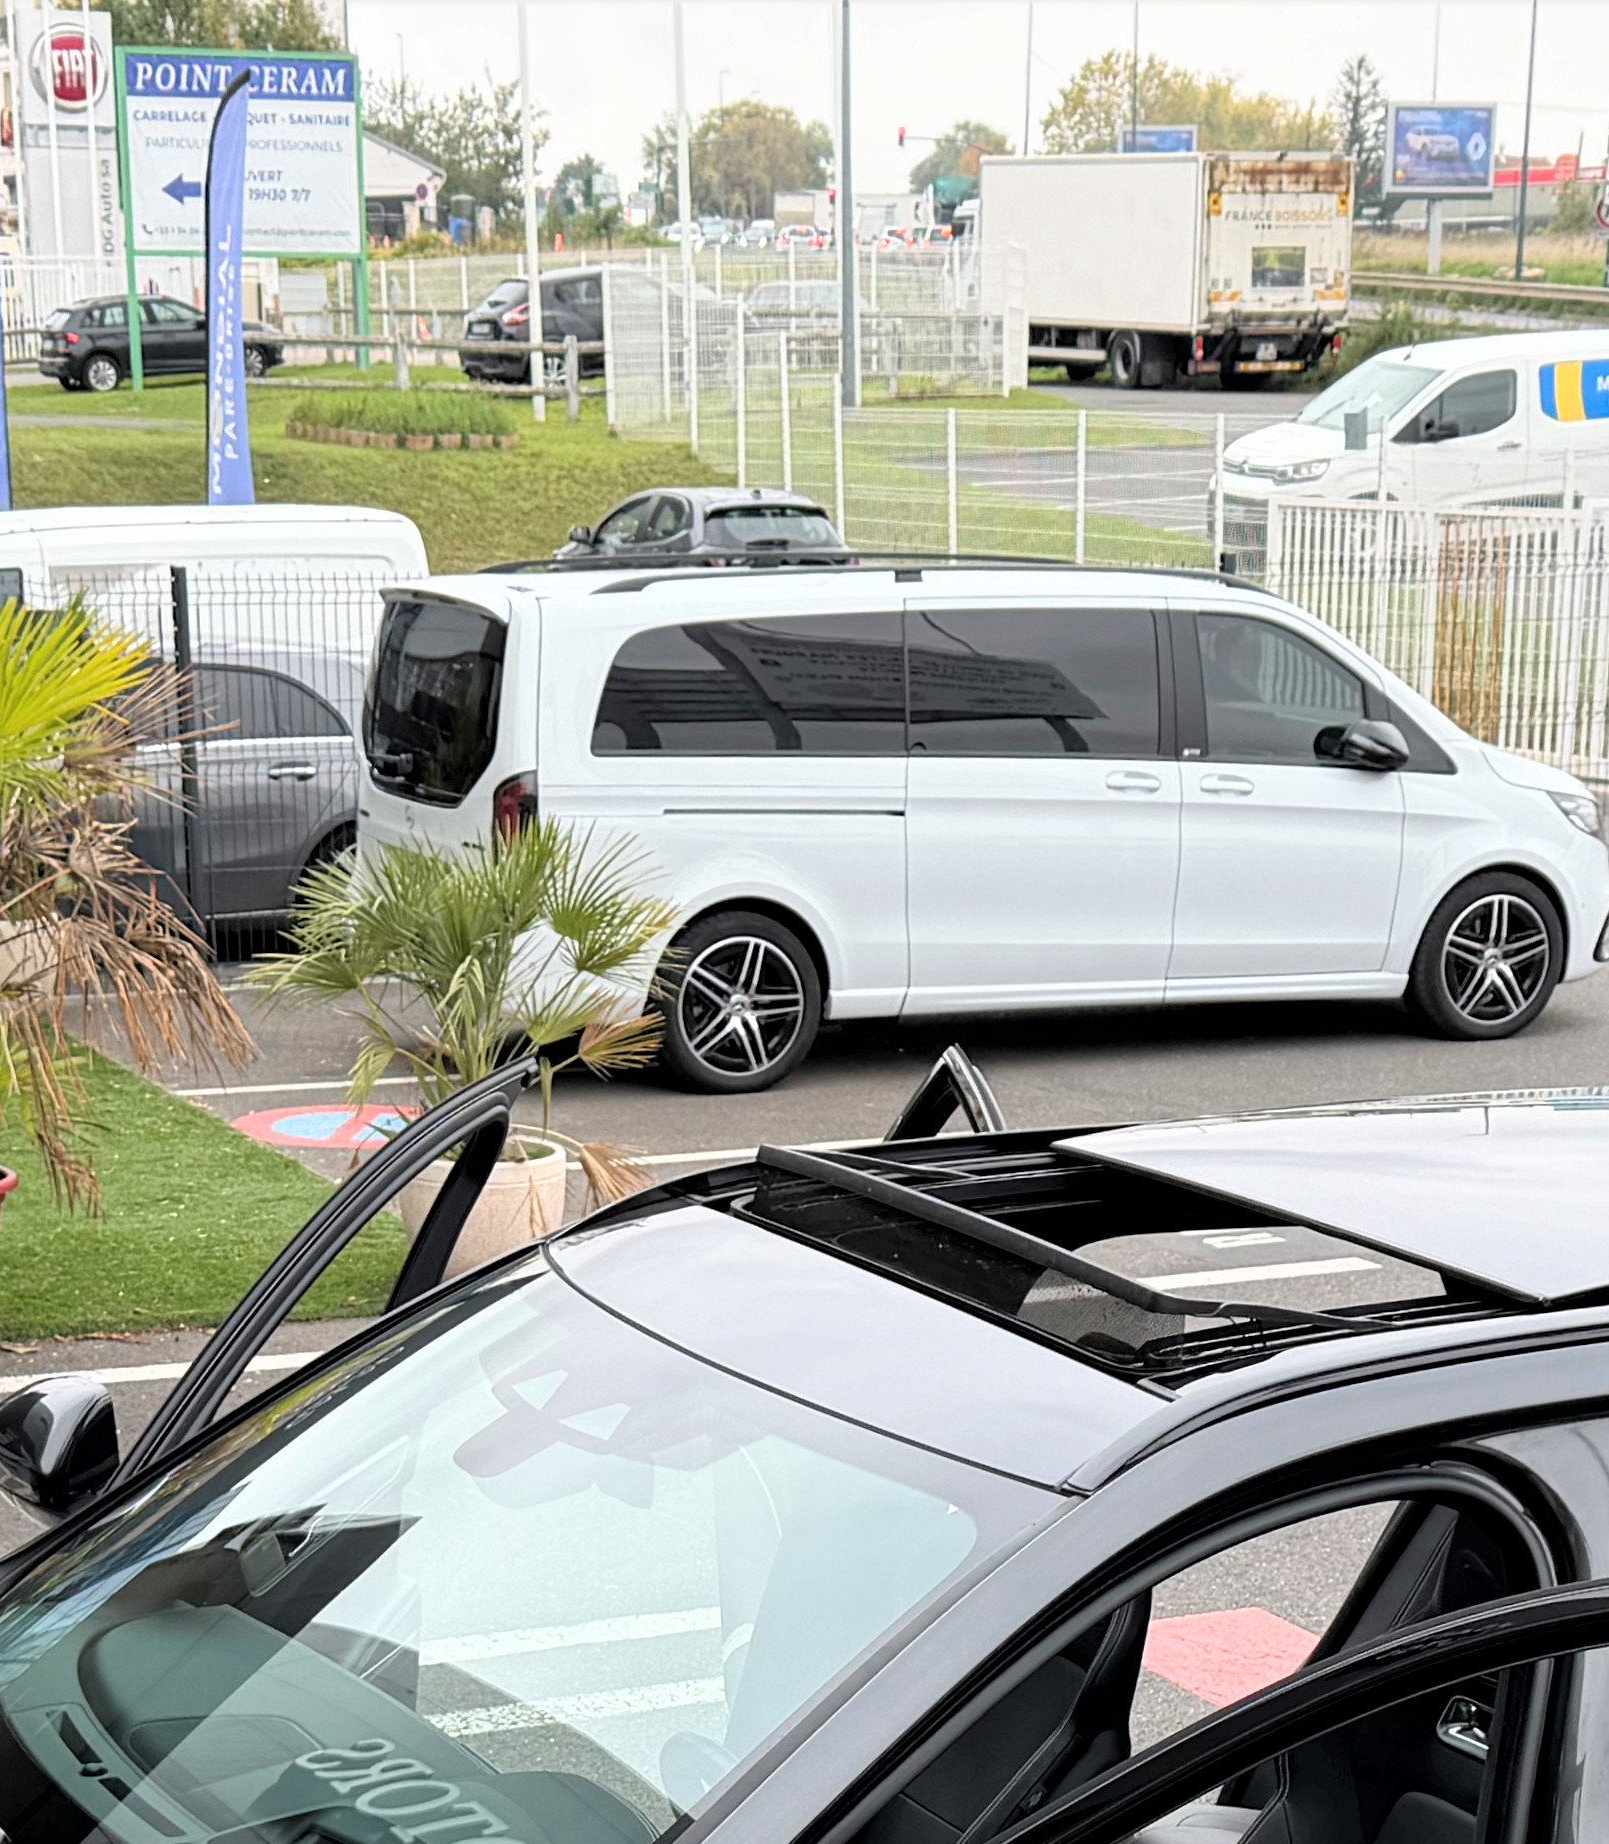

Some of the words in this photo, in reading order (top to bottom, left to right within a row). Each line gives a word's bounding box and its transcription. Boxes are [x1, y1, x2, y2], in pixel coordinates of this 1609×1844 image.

[136, 62, 232, 92] POINT
[133, 109, 207, 124] CARRELAGE
[289, 113, 351, 127] SANITAIRE
[101, 183, 112, 225] Auto
[1224, 210, 1273, 222] FRANCE
[1275, 210, 1333, 223] BOISSONS
